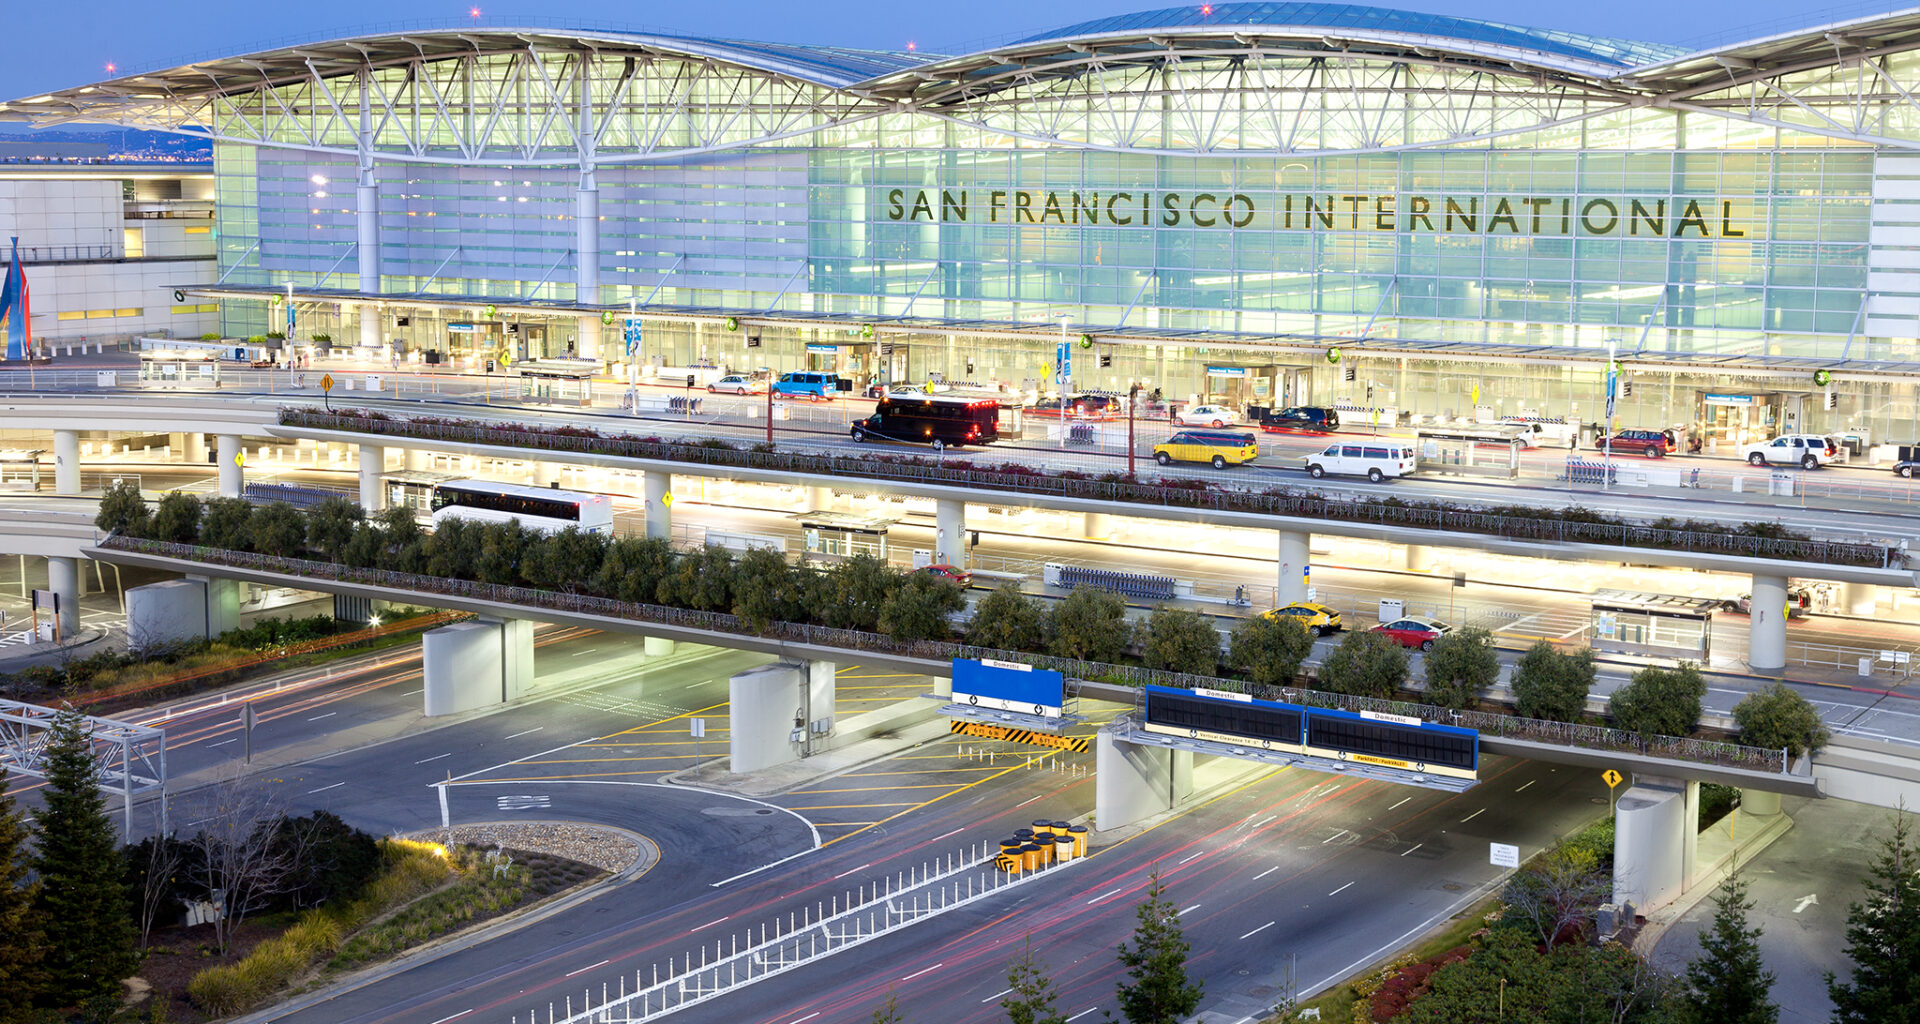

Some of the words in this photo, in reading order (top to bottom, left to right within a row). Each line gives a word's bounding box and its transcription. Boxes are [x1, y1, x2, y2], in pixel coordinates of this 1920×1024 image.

[888, 189, 937, 222] SAN
[988, 190, 1256, 228] FRANCISCO
[1284, 194, 1745, 237] INTERNATIONAL
[993, 661, 1020, 670] Domestic
[1206, 690, 1235, 699] Domestic
[1374, 713, 1406, 723] Domestic
